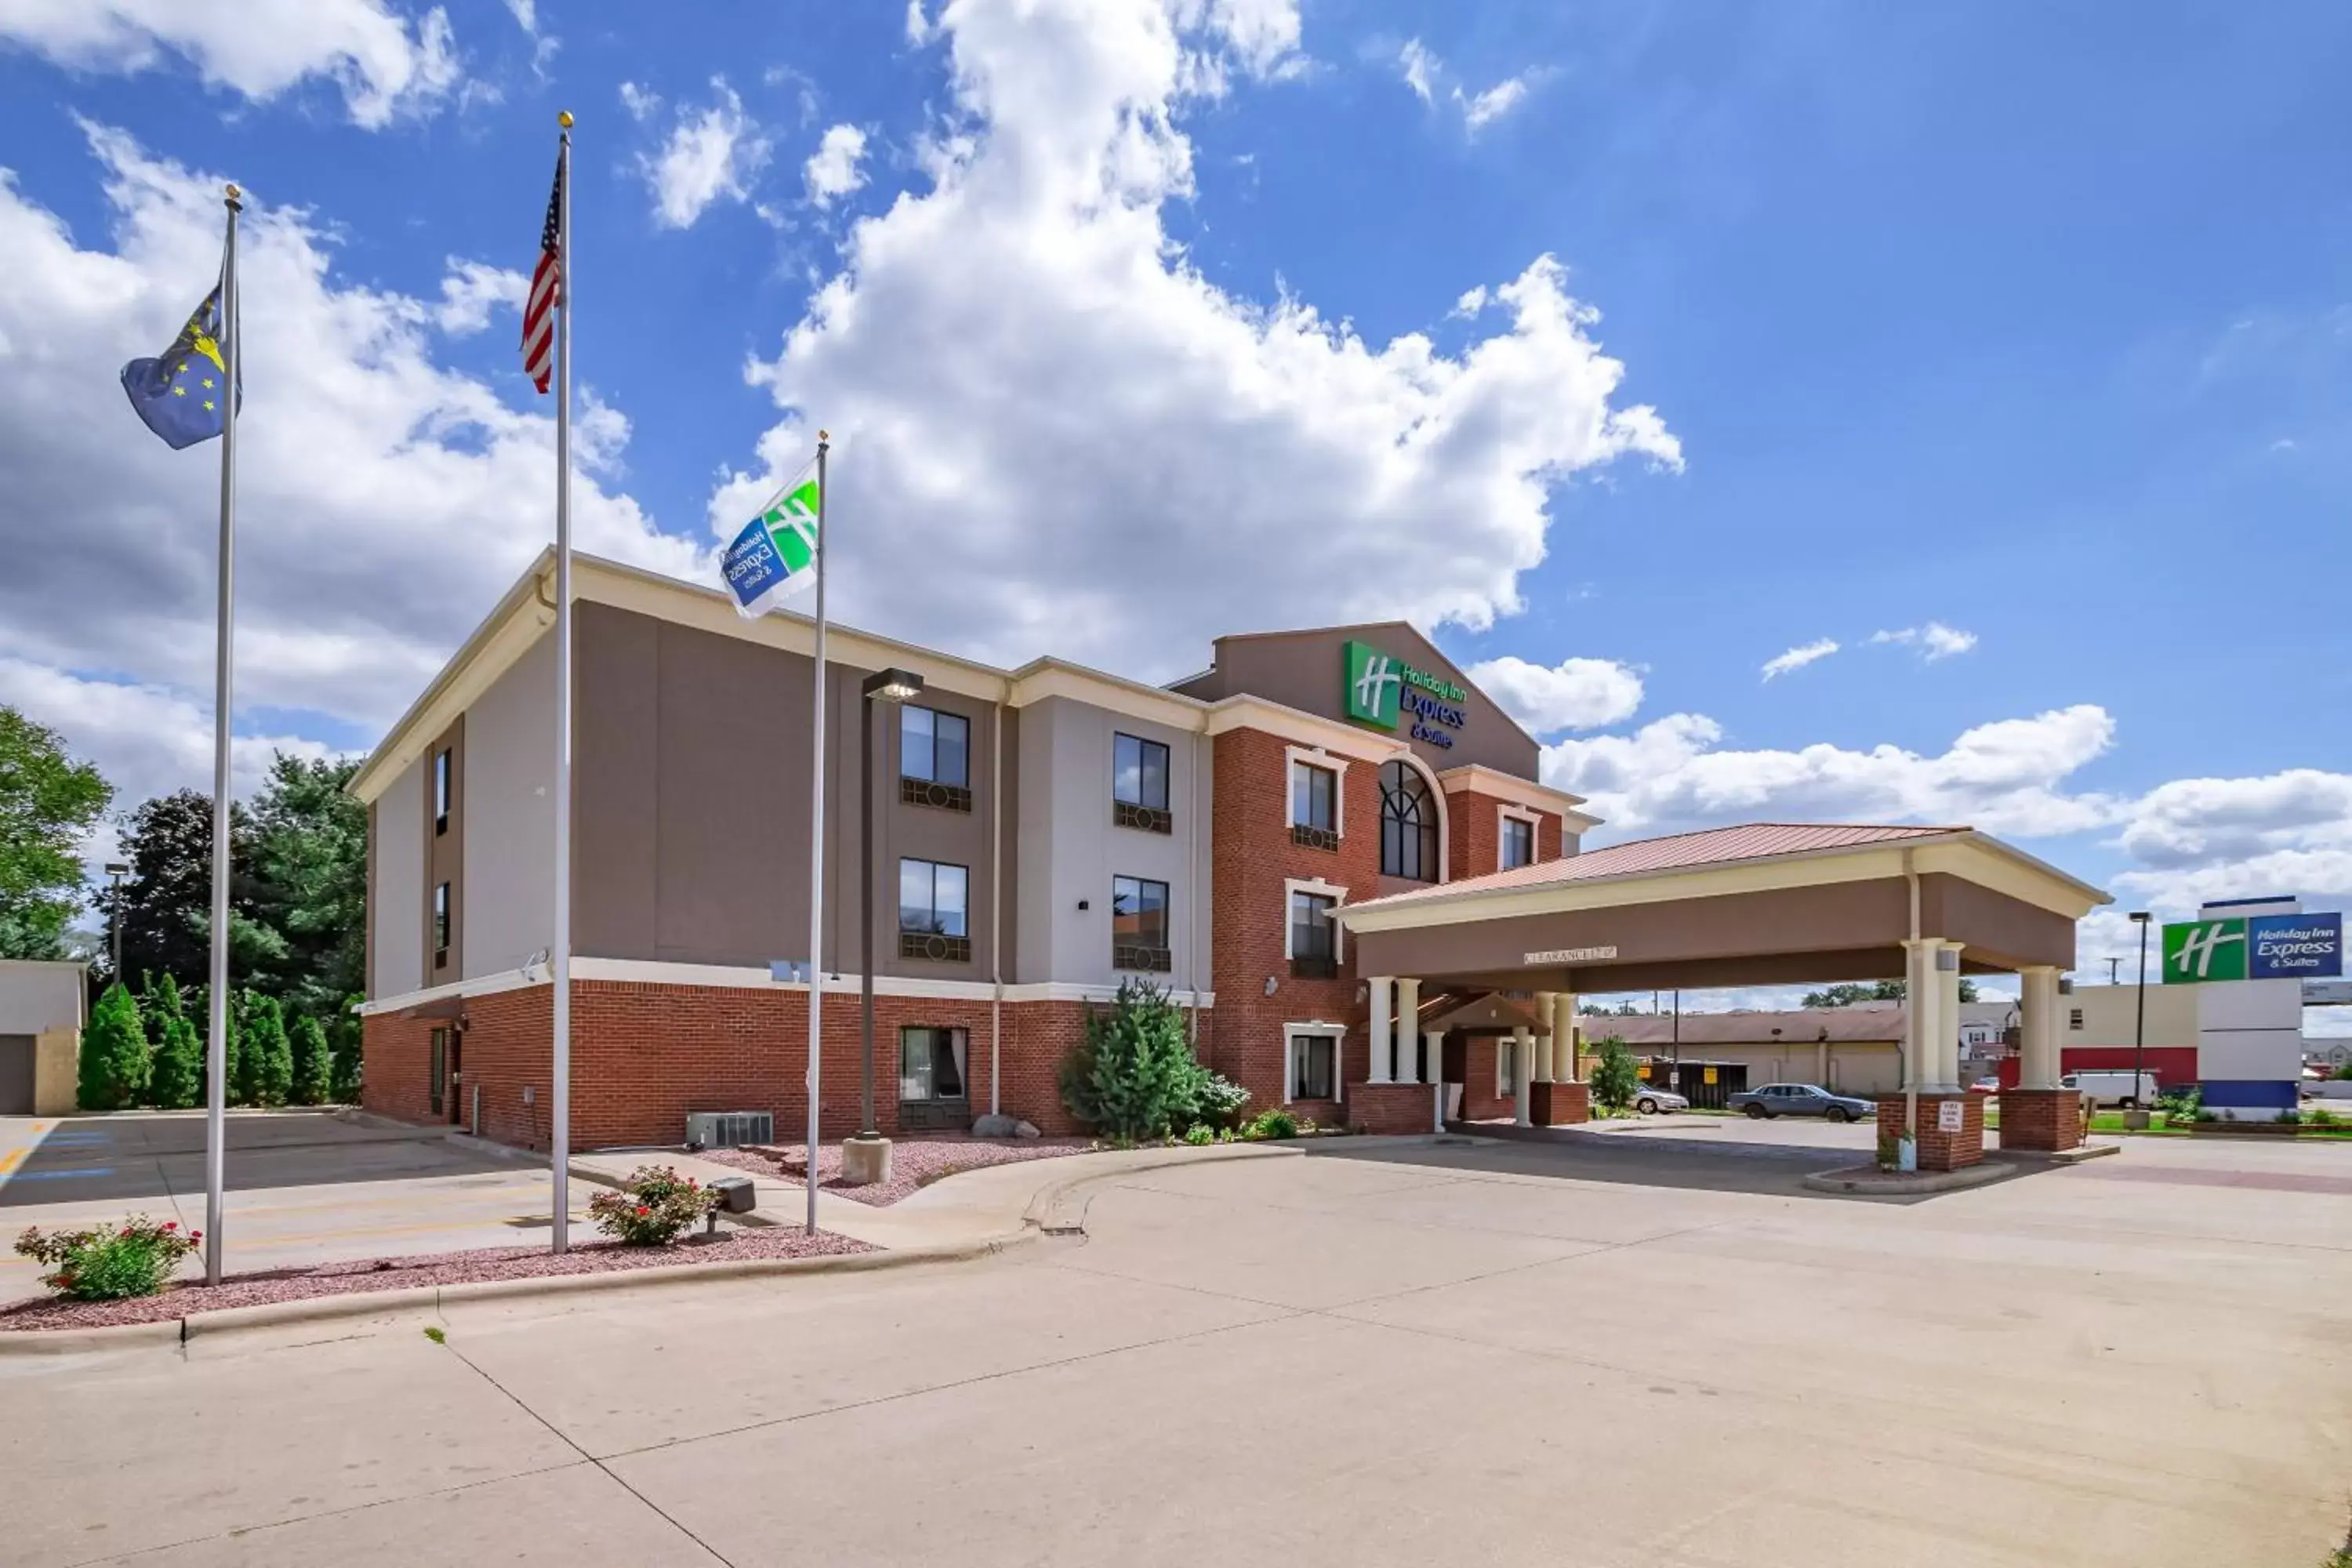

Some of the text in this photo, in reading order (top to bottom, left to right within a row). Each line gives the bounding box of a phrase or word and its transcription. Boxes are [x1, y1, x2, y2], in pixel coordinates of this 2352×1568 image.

[1402, 665, 1468, 702] Holiday Inn
[1402, 685, 1467, 728] Express
[2257, 927, 2335, 941] Holiday Inn
[2257, 941, 2335, 958] Express
[2270, 957, 2320, 968] & Suites
